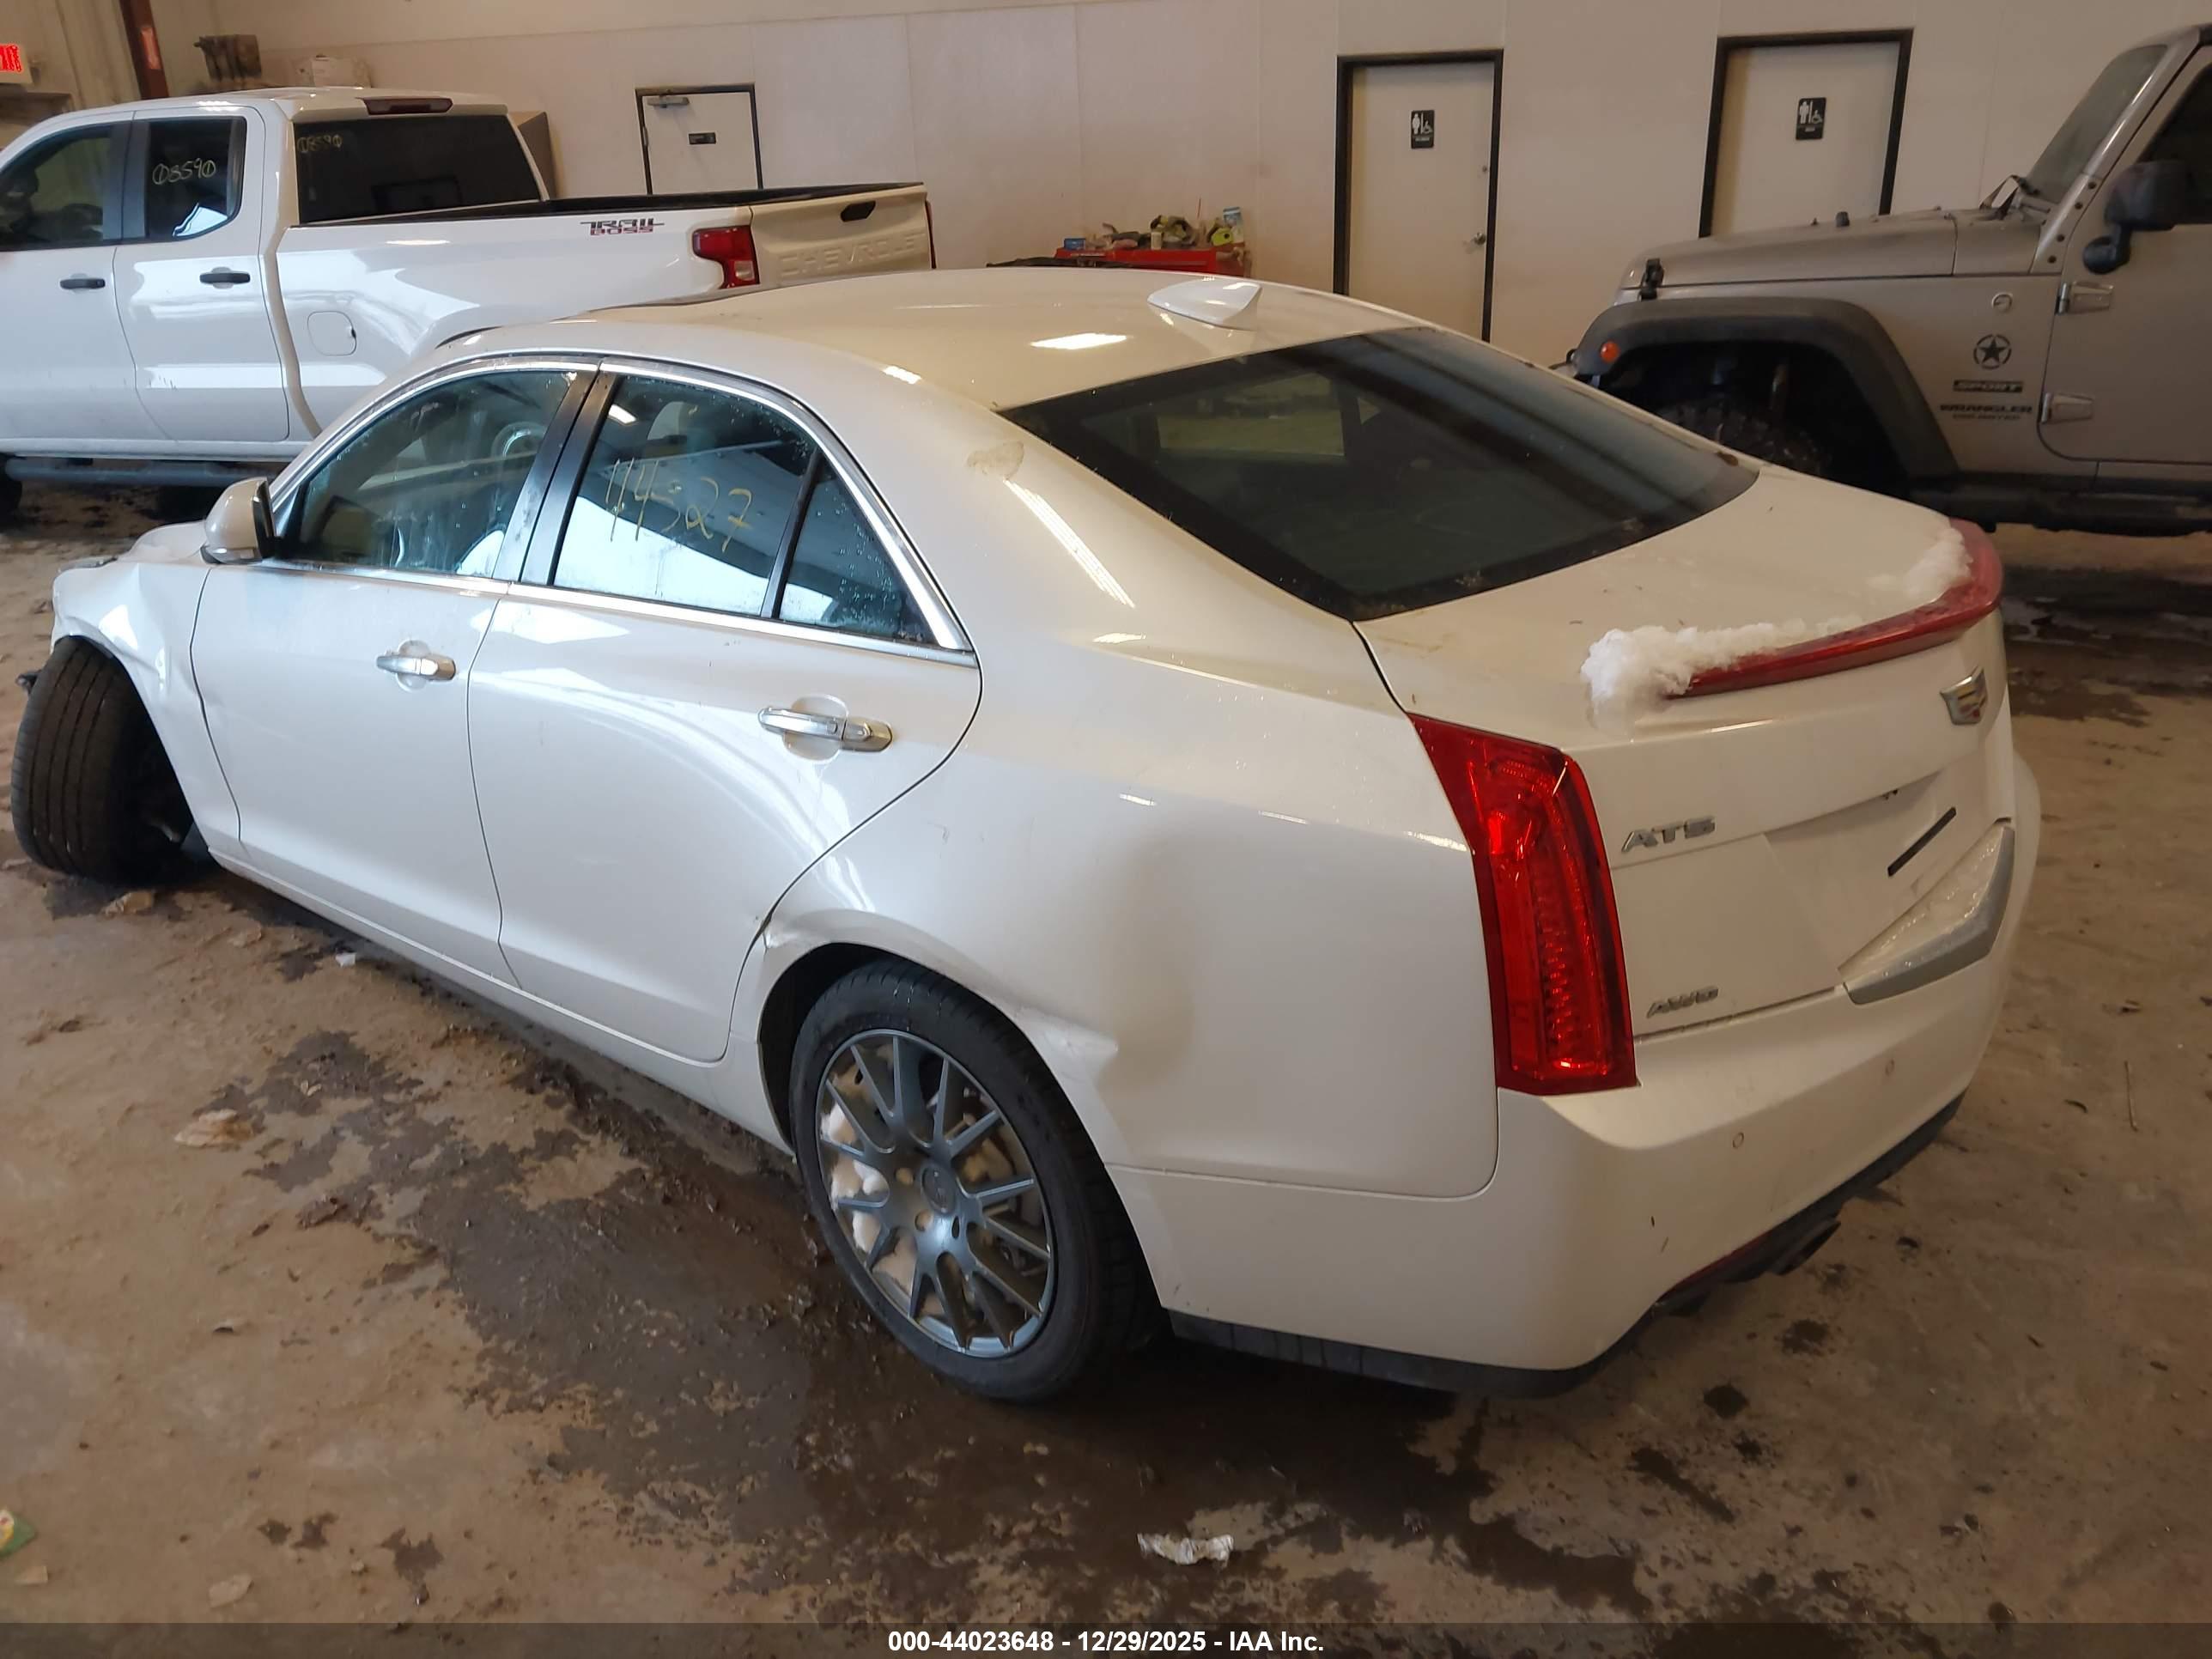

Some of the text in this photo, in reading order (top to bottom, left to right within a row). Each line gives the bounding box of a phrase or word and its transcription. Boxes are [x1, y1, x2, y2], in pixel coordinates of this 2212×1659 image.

[580, 218, 665, 228] TRAIL
[590, 227, 653, 236] BOSS
[1940, 404, 2033, 413] WRANGLER
[1620, 816, 1717, 854] ATS
[1646, 986, 1719, 1019] AWD
